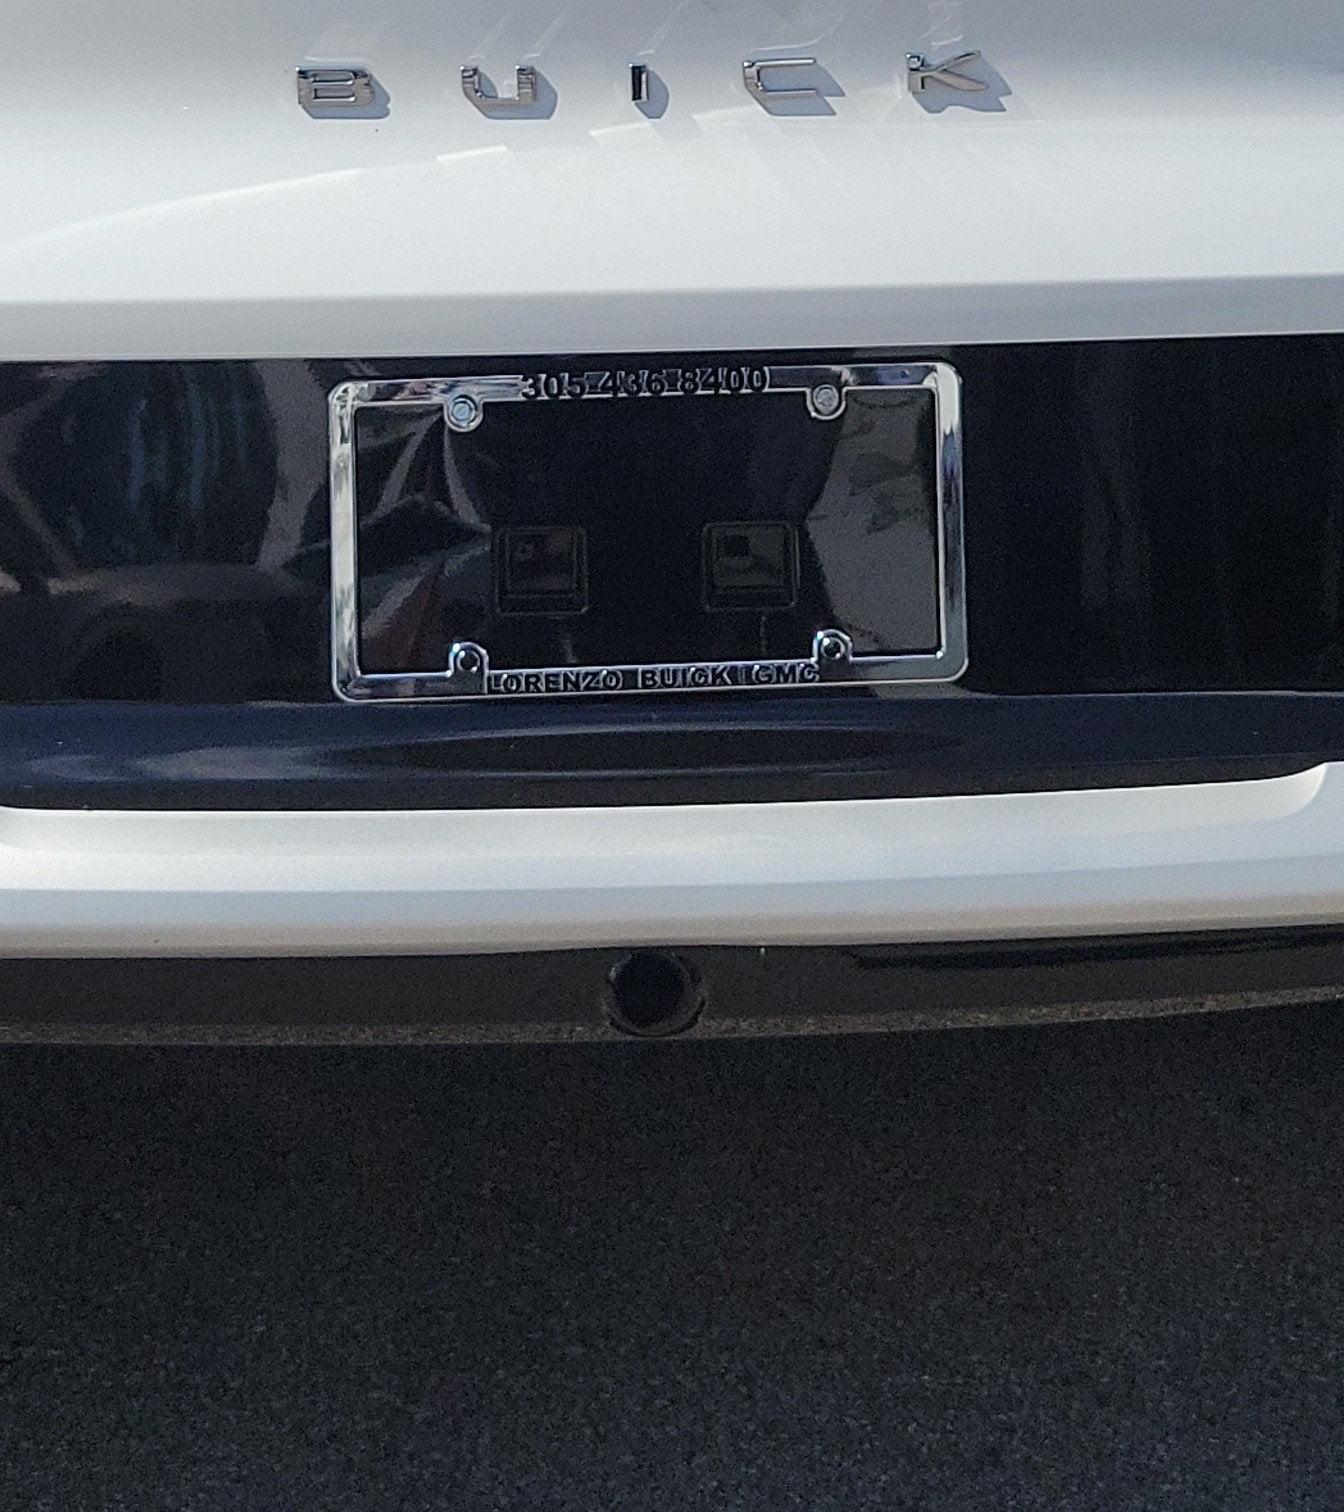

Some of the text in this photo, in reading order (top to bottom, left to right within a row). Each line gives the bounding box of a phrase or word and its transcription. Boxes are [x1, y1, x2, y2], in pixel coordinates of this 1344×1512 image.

[295, 49, 994, 107] BUICK
[488, 661, 820, 694] LORENZO BUICK GMC
